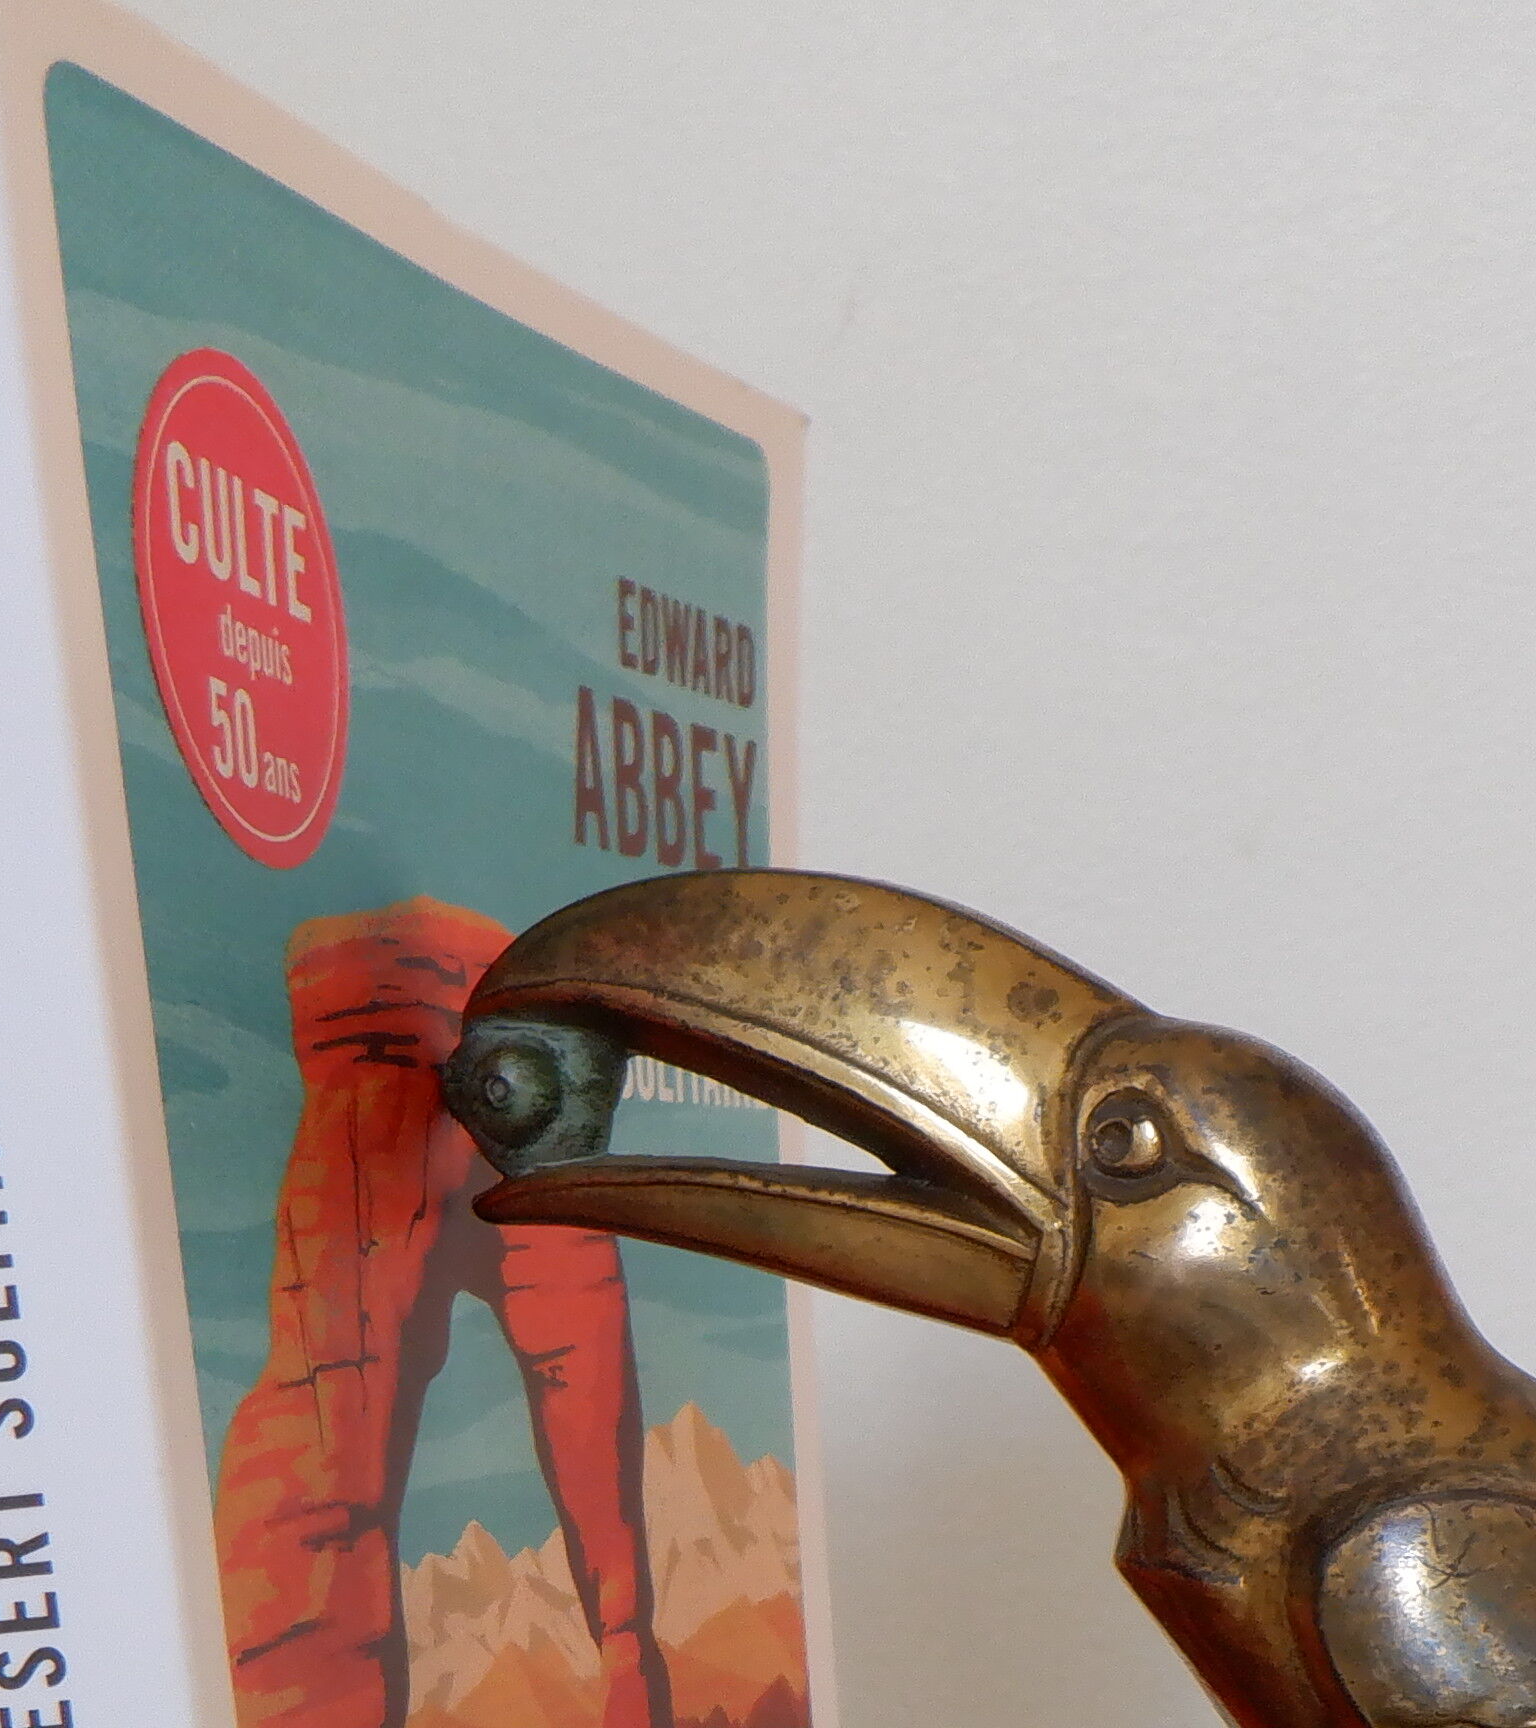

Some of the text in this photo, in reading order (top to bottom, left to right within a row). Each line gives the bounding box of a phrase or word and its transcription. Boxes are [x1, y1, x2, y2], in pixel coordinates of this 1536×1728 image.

[166, 440, 312, 623] CULTE
[219, 604, 293, 684] depuis
[617, 576, 756, 708] EDWARD
[209, 676, 302, 803] 50 ans
[575, 685, 757, 868] ABBEY
